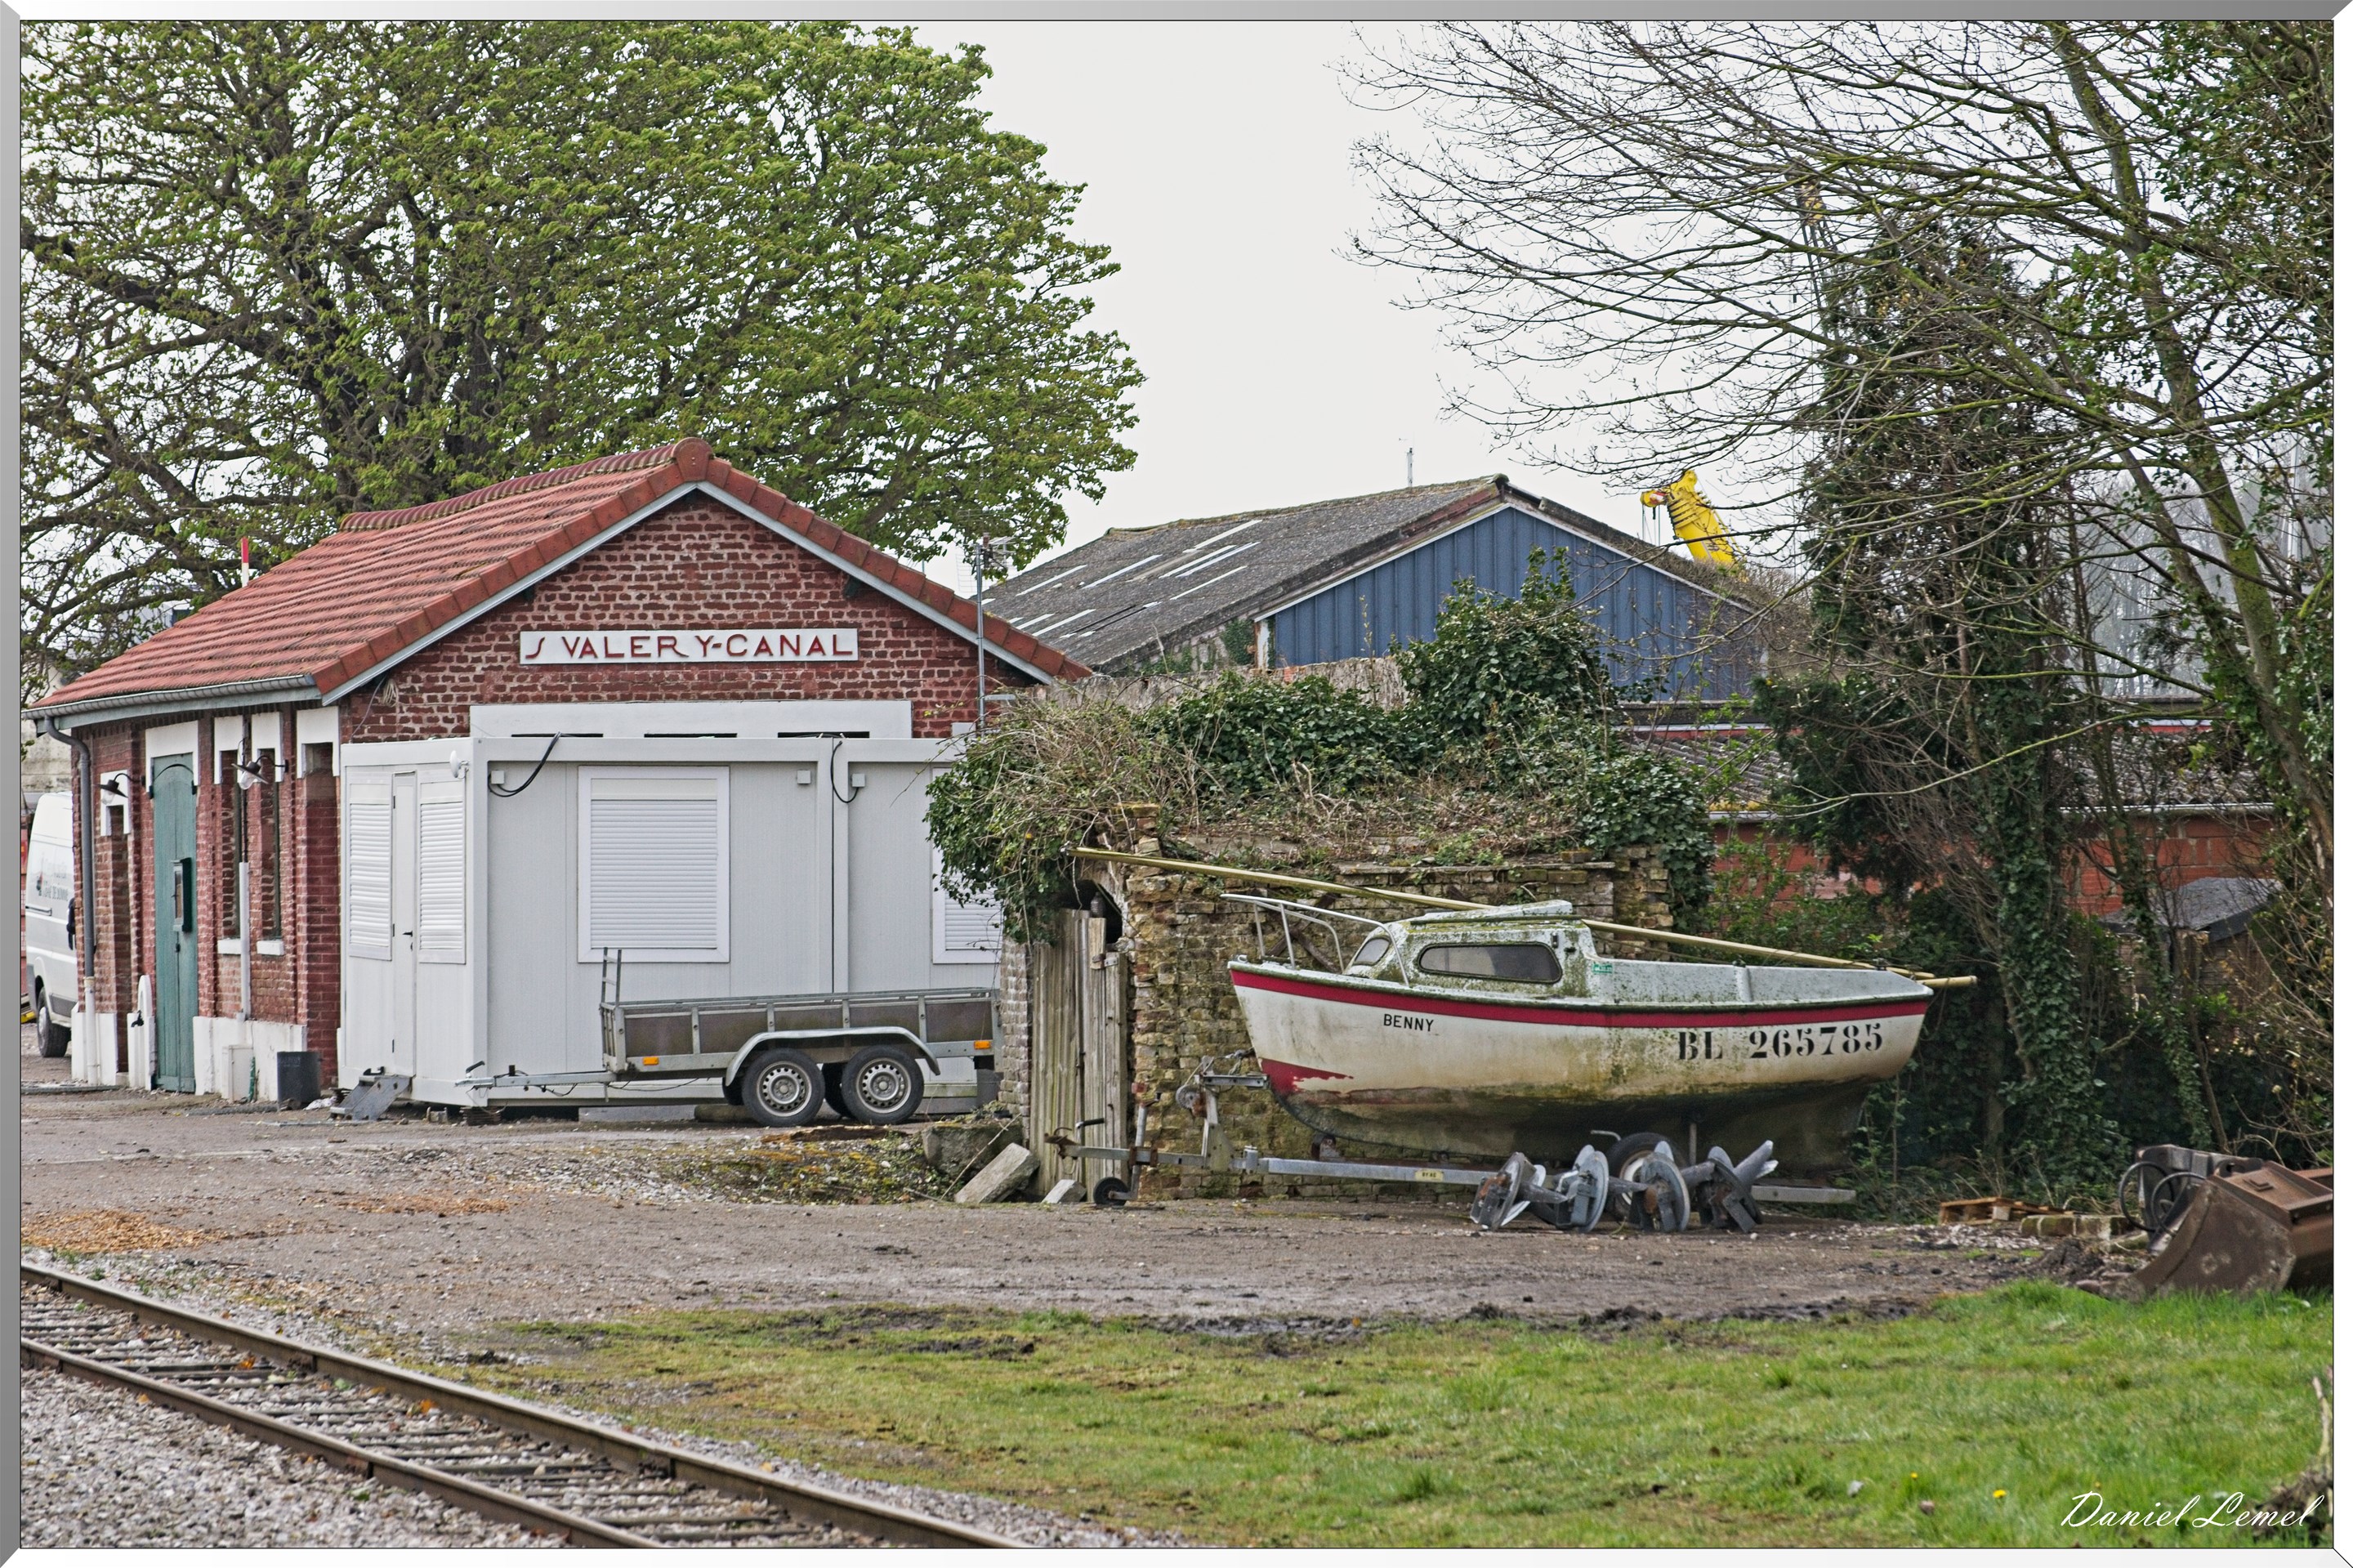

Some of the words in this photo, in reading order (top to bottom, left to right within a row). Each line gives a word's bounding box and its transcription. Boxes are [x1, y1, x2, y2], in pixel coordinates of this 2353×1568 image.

[1383, 1013, 1435, 1032] BENNY
[1677, 1031, 1724, 1061] BL
[1748, 1022, 1883, 1059] 265785
